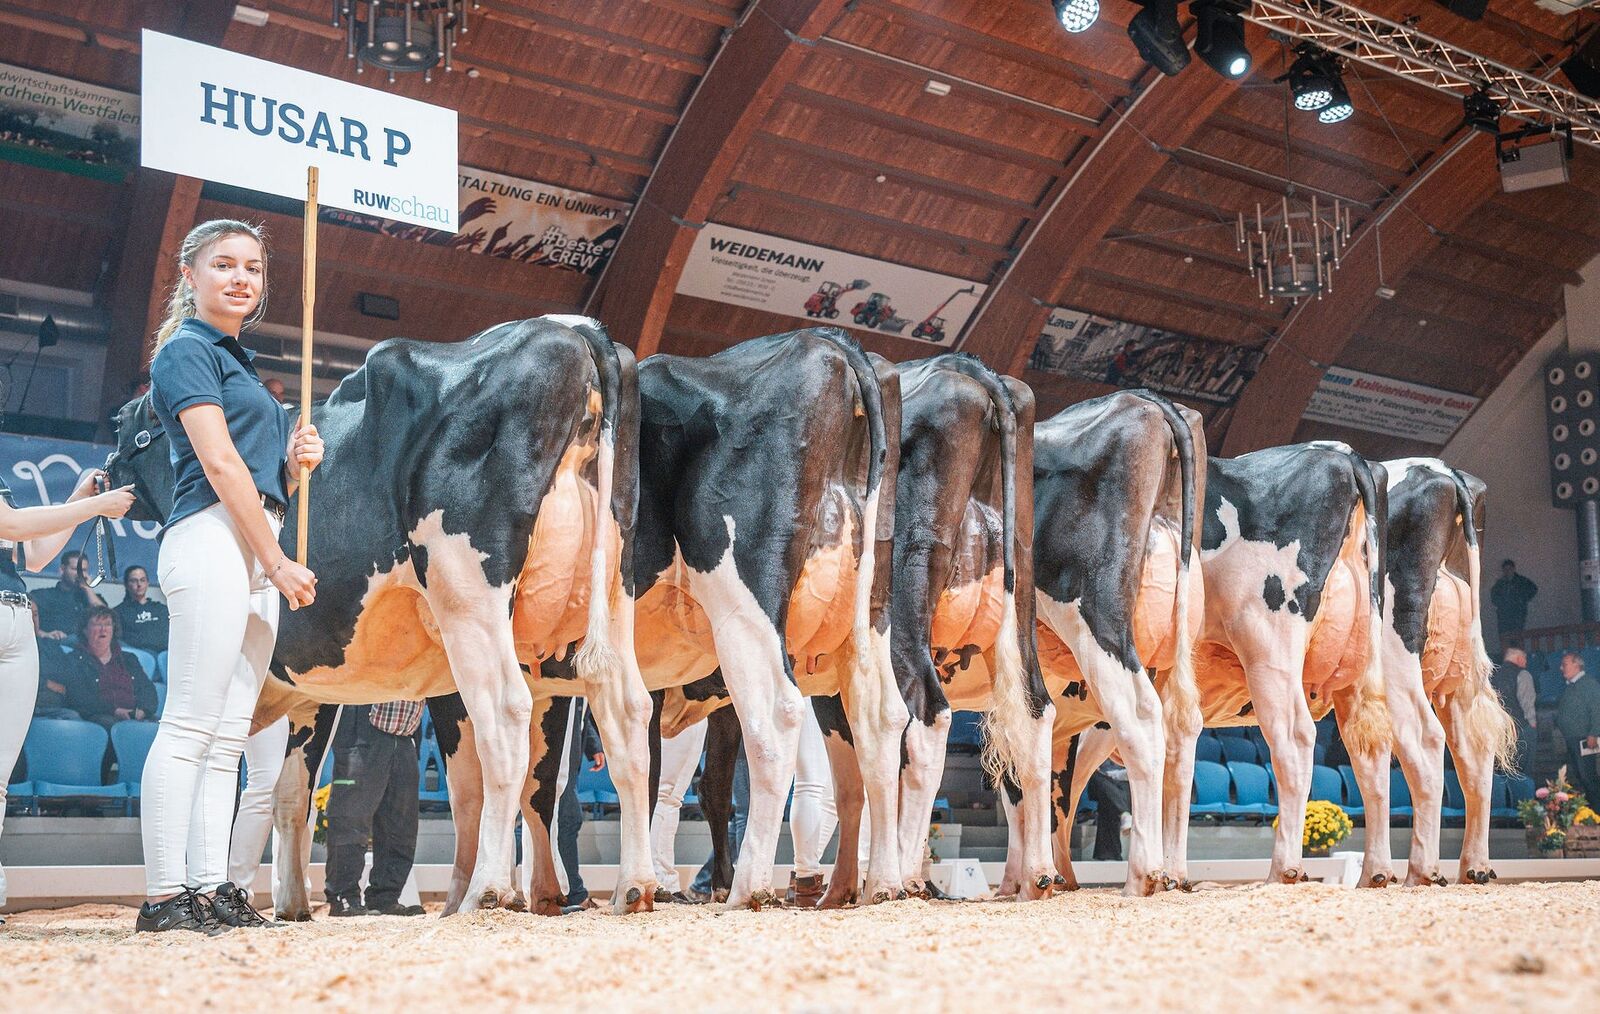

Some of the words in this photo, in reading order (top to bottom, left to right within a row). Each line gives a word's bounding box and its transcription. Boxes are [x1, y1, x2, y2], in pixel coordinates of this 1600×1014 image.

[200, 81, 371, 161] HUSAR
[383, 127, 412, 168] P
[353, 188, 450, 225] RUWschau
[536, 192, 562, 208] EIN
[565, 198, 622, 221] UNIKAT
[542, 226, 603, 256] #beste
[710, 237, 824, 272] WEIDEMANN
[549, 248, 599, 268] CREW
